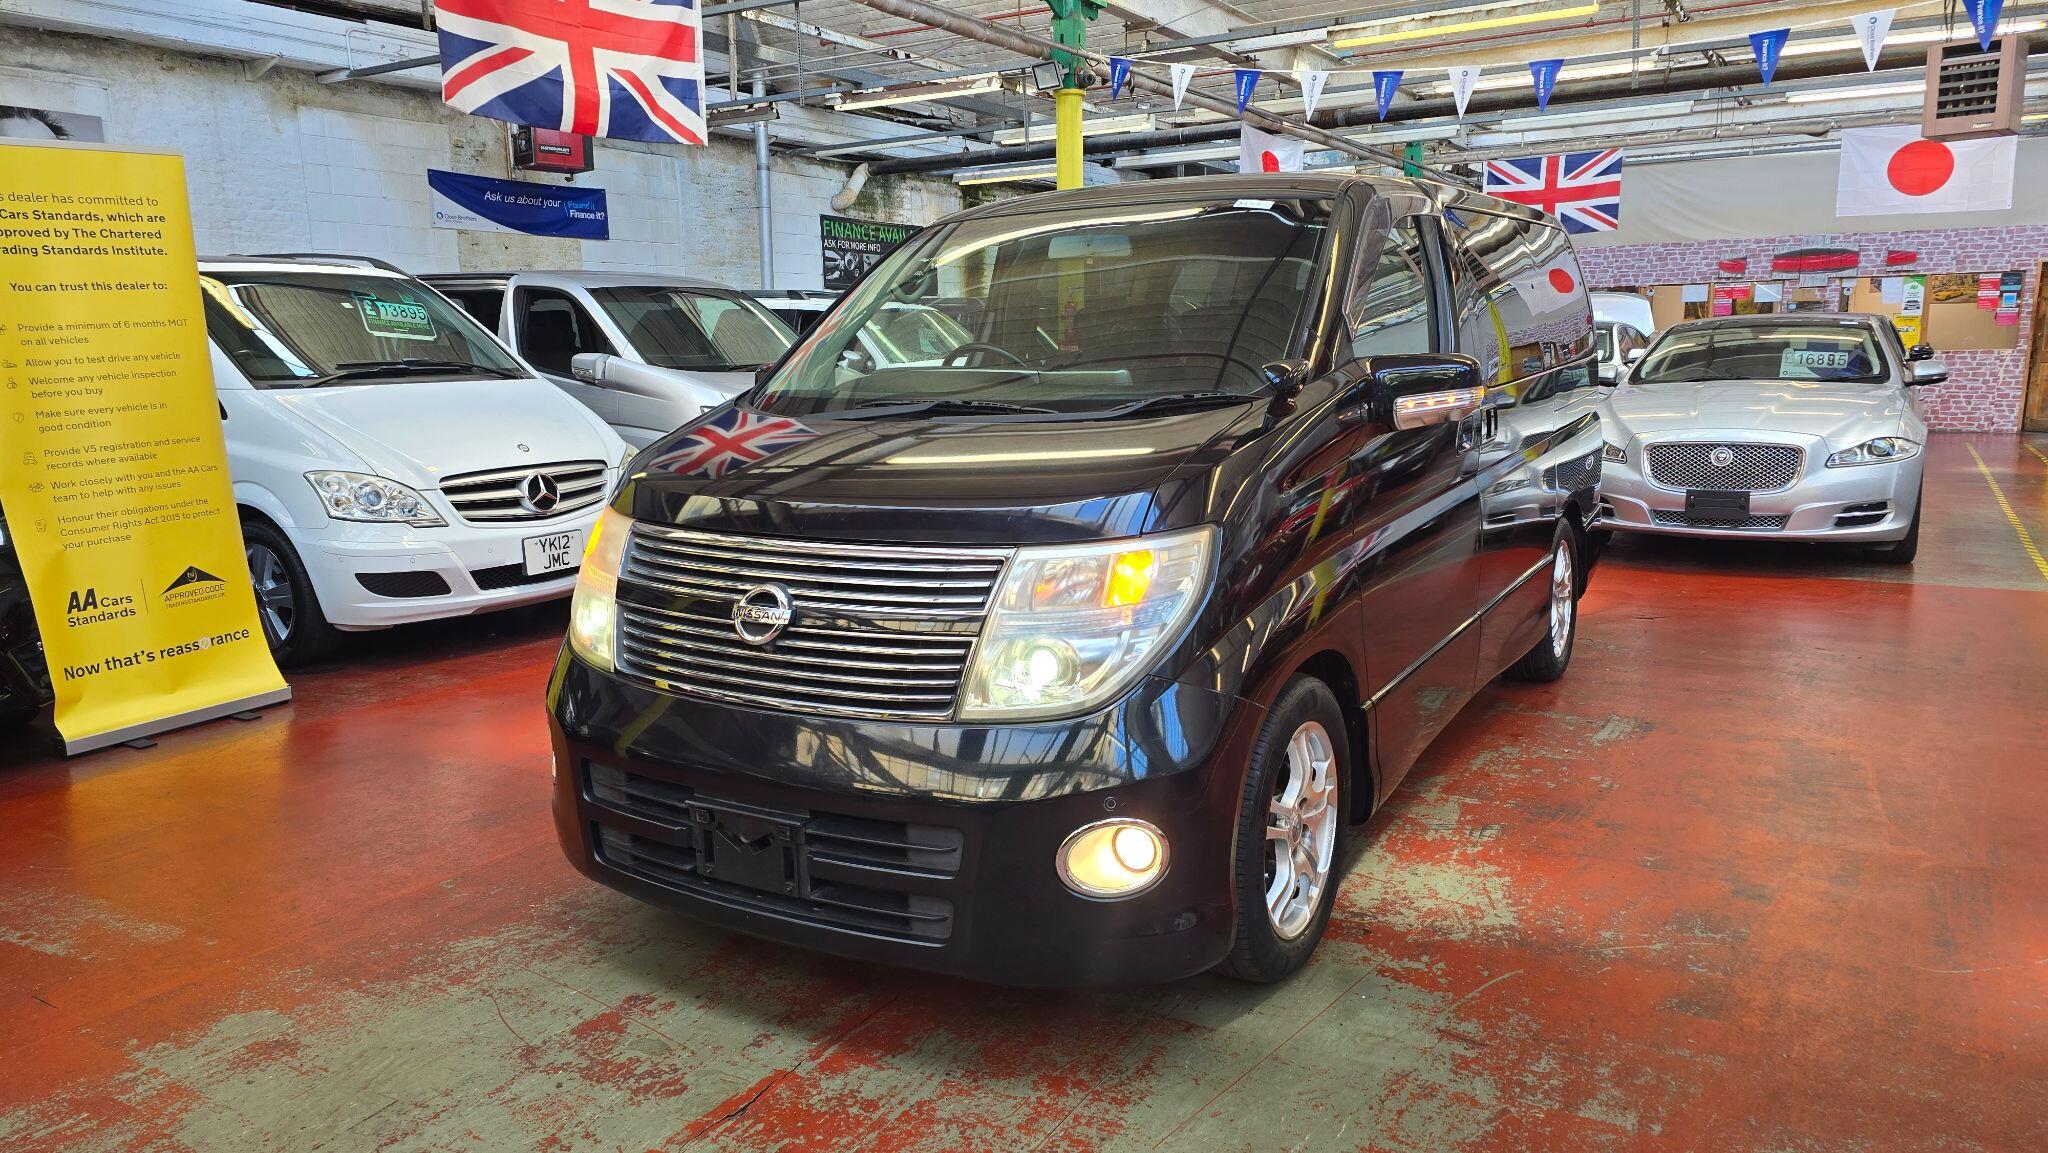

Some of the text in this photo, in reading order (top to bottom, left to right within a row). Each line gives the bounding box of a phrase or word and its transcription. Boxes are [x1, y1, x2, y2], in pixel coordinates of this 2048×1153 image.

[8, 192, 48, 203] dealer
[52, 194, 74, 204] has
[78, 195, 144, 206] committed
[147, 197, 159, 206] to
[484, 190, 502, 201] Ask
[517, 195, 542, 206] about
[543, 200, 561, 208] your
[568, 201, 596, 210] Found it
[0, 209, 29, 219] Cars
[33, 210, 104, 222] Standards,
[107, 213, 143, 222] which
[570, 209, 605, 220] Finance it?
[54, 228, 69, 239] by
[72, 228, 96, 238] The
[100, 229, 161, 239] Chartered
[823, 219, 876, 240] FINANCE
[42, 245, 109, 255] Standards
[112, 246, 168, 255] Institute.
[824, 239, 881, 252] ASK FOR MORE INFO
[10, 282, 168, 291] You can trust this dealer to:
[380, 303, 426, 320] 13895
[18, 323, 54, 332] Provide
[66, 322, 110, 330] minimum
[132, 320, 167, 328] months
[168, 319, 188, 327] MOT
[35, 337, 47, 345] all
[49, 336, 90, 345] vehicles
[25, 352, 181, 368] Allow you to test drive any vehicle
[1798, 354, 1847, 366] 16895
[28, 369, 177, 386] Welcome any vehicle inspection
[31, 387, 103, 399] before you buy
[35, 409, 61, 419] Make
[64, 408, 85, 417] sure
[88, 407, 114, 415] every
[116, 403, 148, 412] vehicle
[150, 402, 157, 410] is
[38, 420, 112, 434] good condition
[44, 436, 201, 457] Provide V5 registration and service
[47, 453, 158, 471] records where available
[50, 464, 218, 490] Work closely with you and the AA Cars
[53, 493, 78, 502] team
[80, 491, 90, 499] to
[92, 489, 113, 499] help
[116, 487, 137, 495] with
[155, 481, 182, 489] issues
[58, 498, 208, 525] Honour their obligations under the
[60, 524, 110, 537] Consumer
[112, 519, 142, 531] Rights
[161, 514, 181, 523] 2015
[183, 512, 191, 520] to
[192, 508, 221, 520] protect
[62, 534, 132, 551] your purchase
[539, 535, 570, 553] YK12
[544, 552, 569, 569] JMC
[67, 588, 133, 614] AA Cars
[164, 584, 225, 602] APPROVED CODE
[67, 608, 136, 627] Standards
[735, 608, 780, 621] NISSAN
[64, 662, 100, 681] Now
[104, 650, 155, 671] that's
